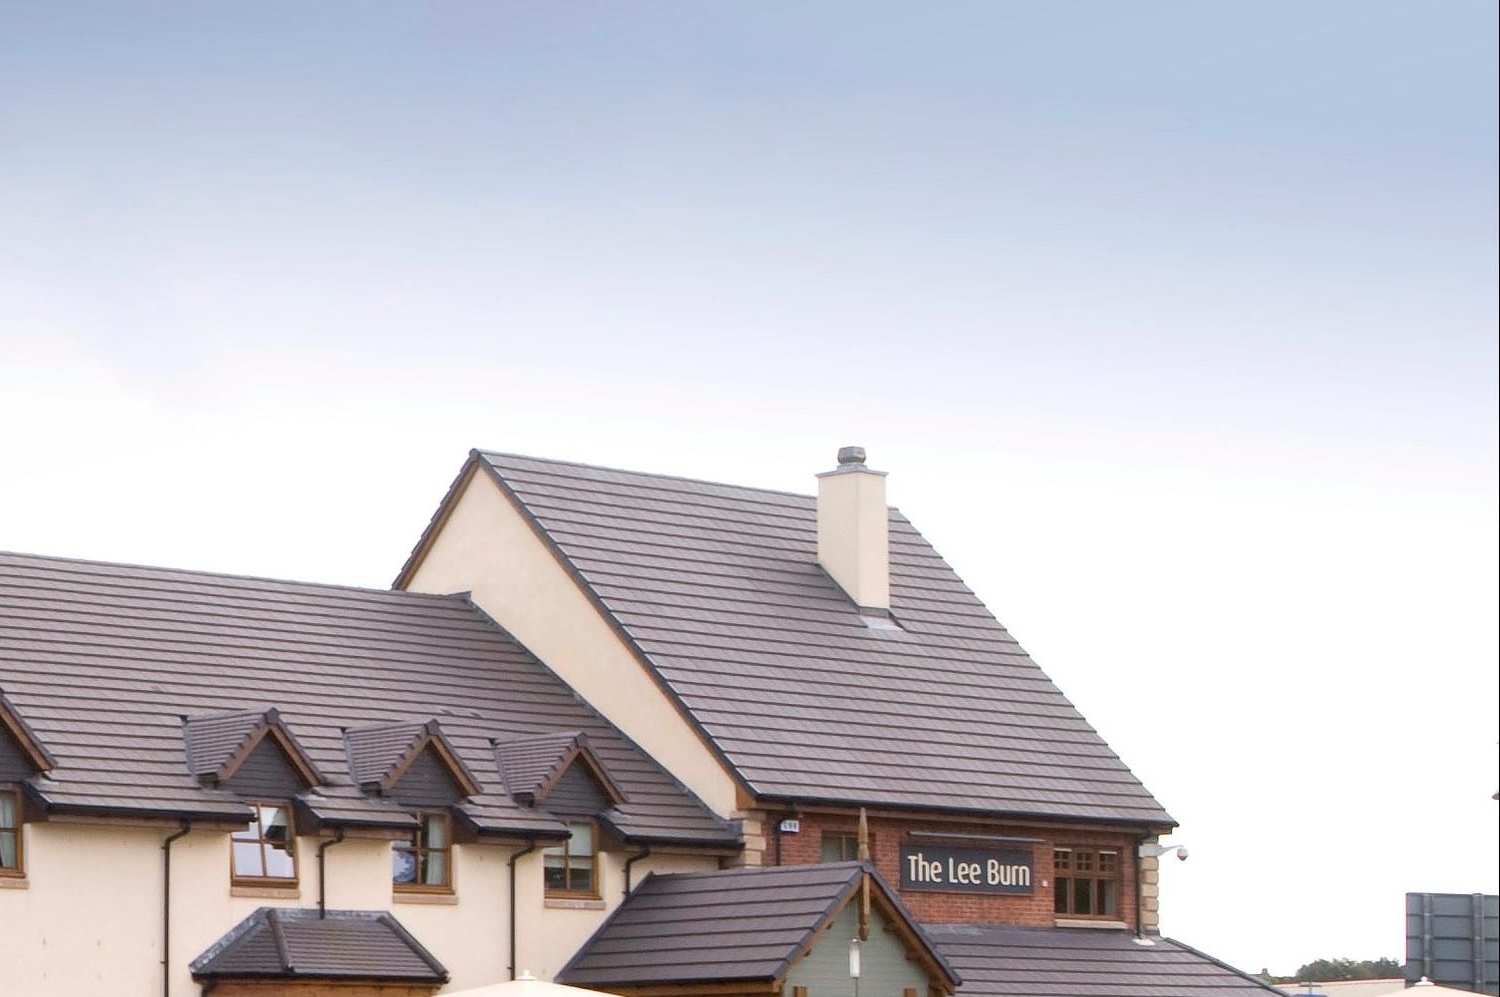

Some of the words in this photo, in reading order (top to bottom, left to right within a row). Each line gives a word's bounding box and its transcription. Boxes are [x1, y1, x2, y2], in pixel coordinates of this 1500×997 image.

[907, 853, 942, 882] The
[948, 857, 981, 884] Lee
[987, 859, 1030, 886] Burn
